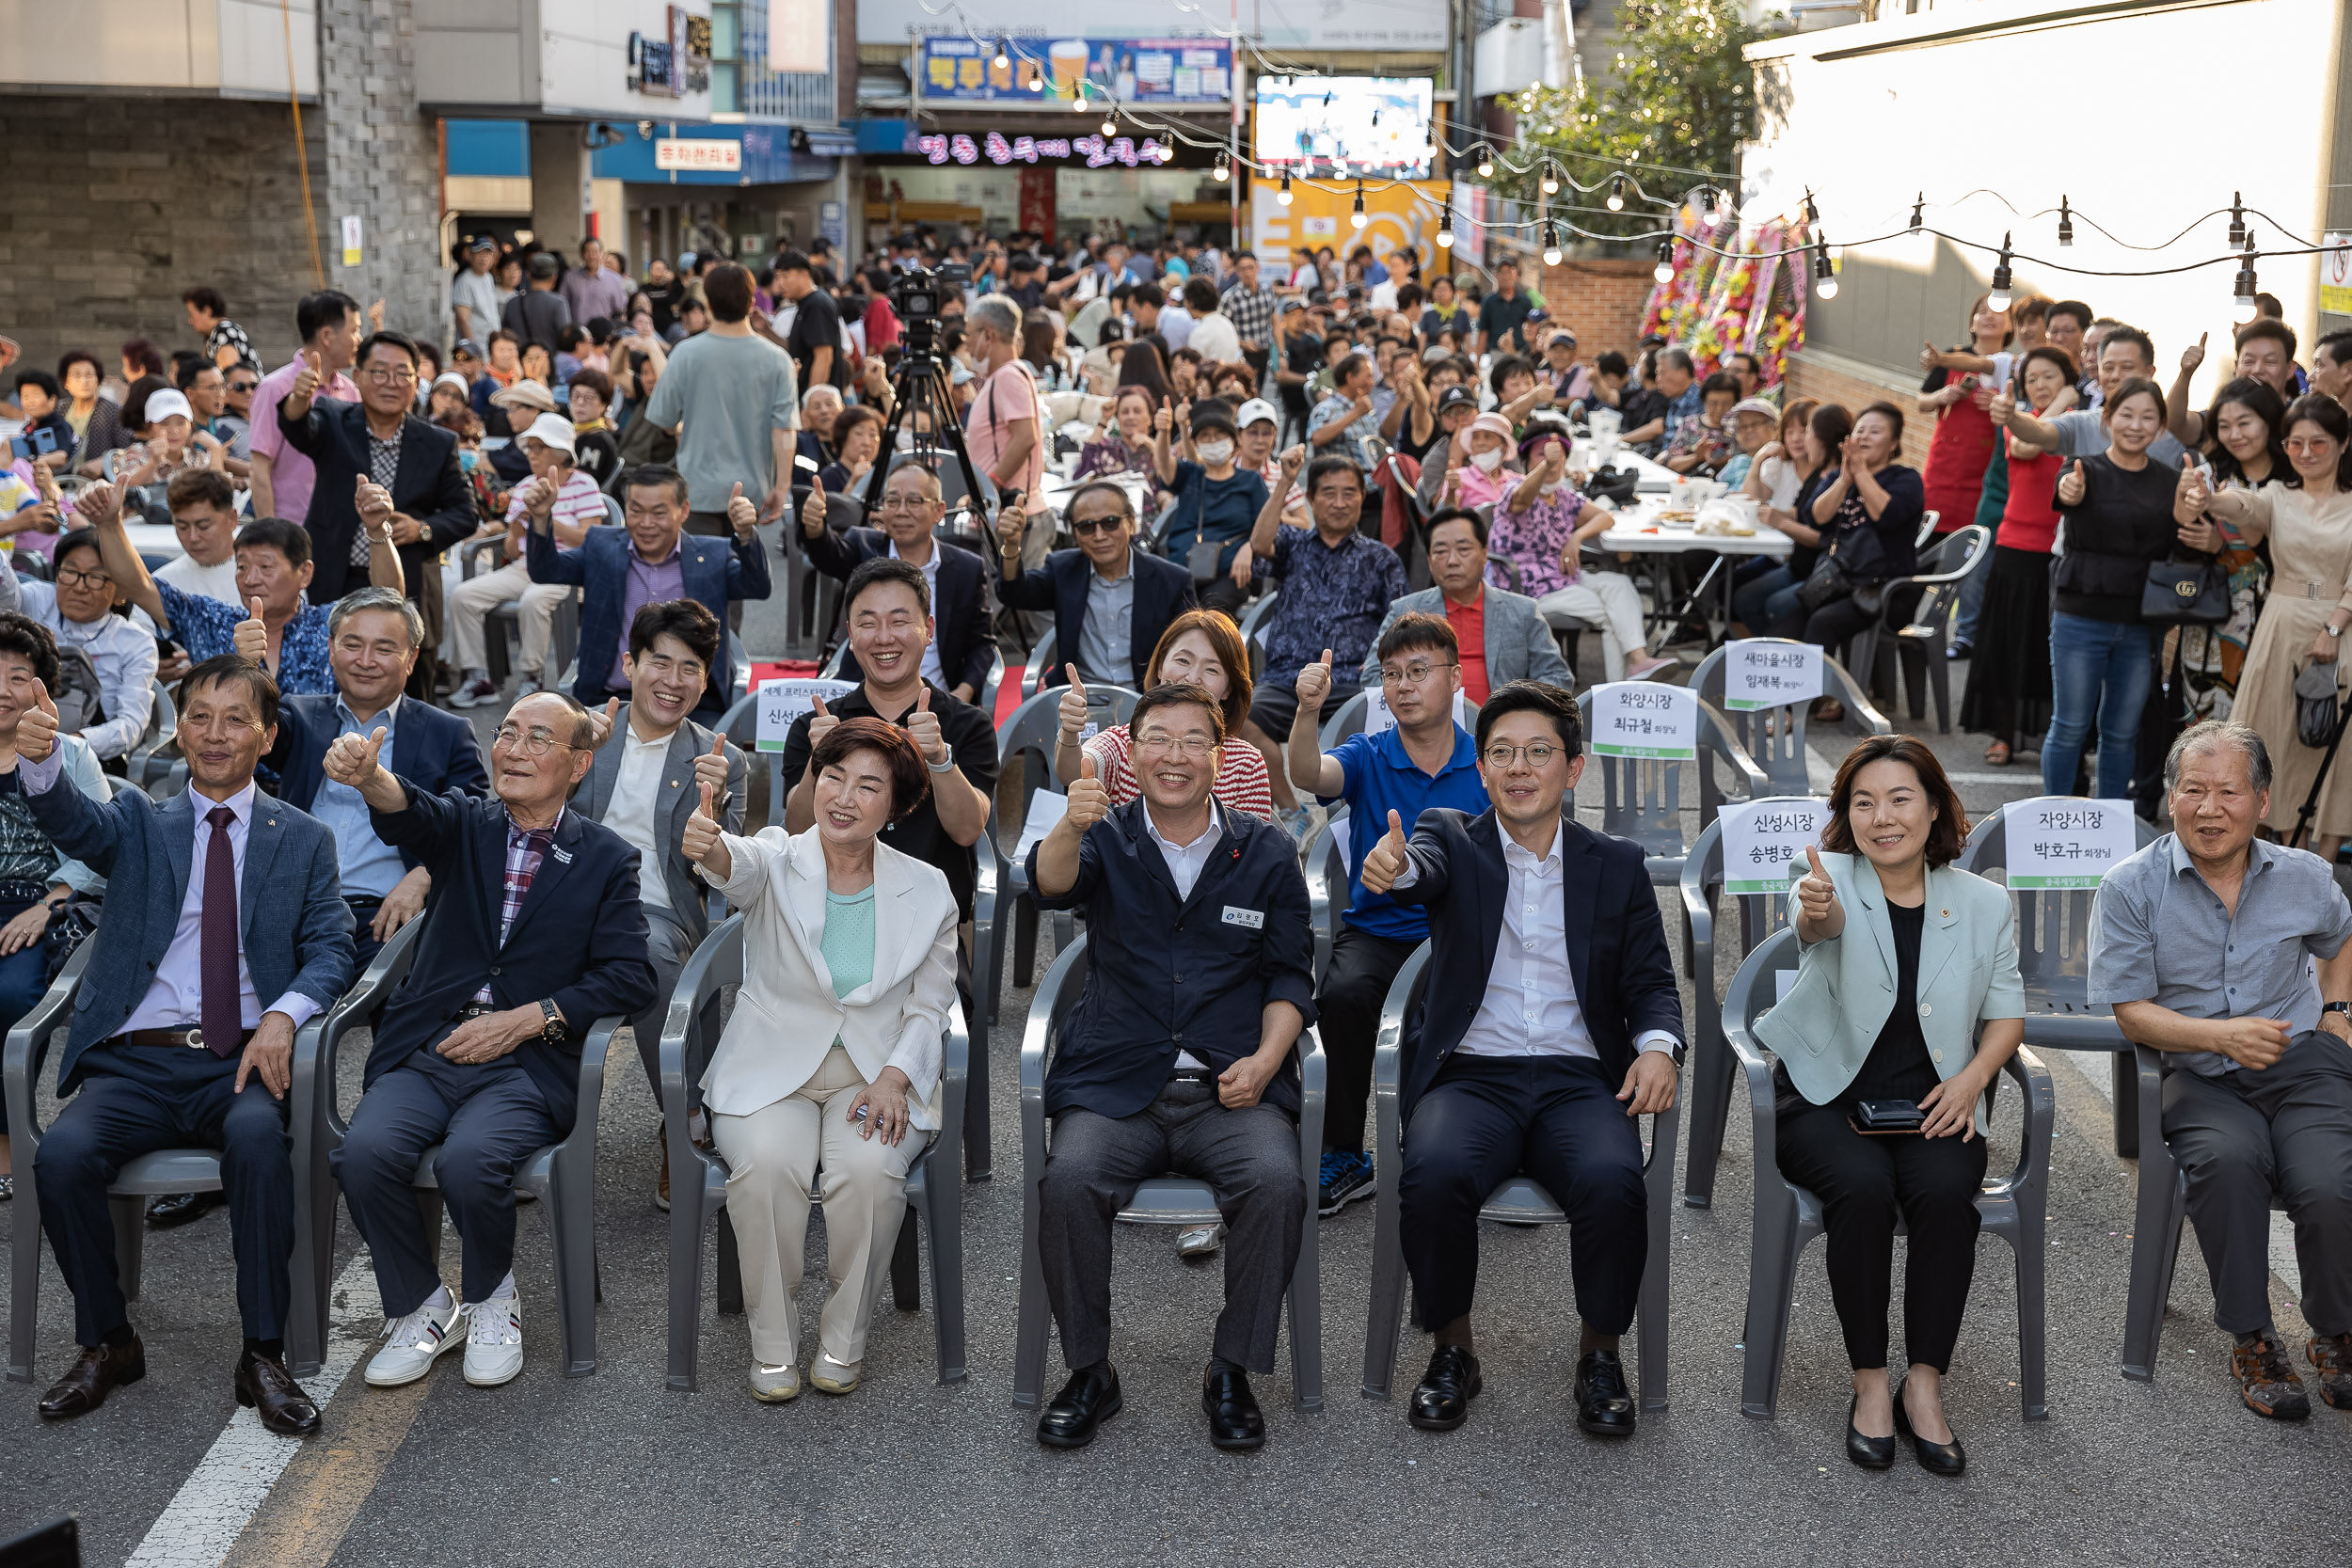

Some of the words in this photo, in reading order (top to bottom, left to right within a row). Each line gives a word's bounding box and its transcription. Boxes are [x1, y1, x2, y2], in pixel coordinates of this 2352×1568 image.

[1744, 652, 1805, 668] 새마을시장
[1745, 674, 1781, 689] 임재복
[763, 687, 782, 697] 세계
[784, 687, 828, 699] 프리스타일
[1620, 692, 1673, 709] 화양시장
[1614, 718, 1652, 735] 최규철
[1755, 813, 1814, 832] 신성시장
[2040, 811, 2104, 830] 자양시장
[1749, 845, 1794, 863] 송병호
[2034, 842, 2082, 860] 박호규
[2084, 847, 2111, 859] 회장님
